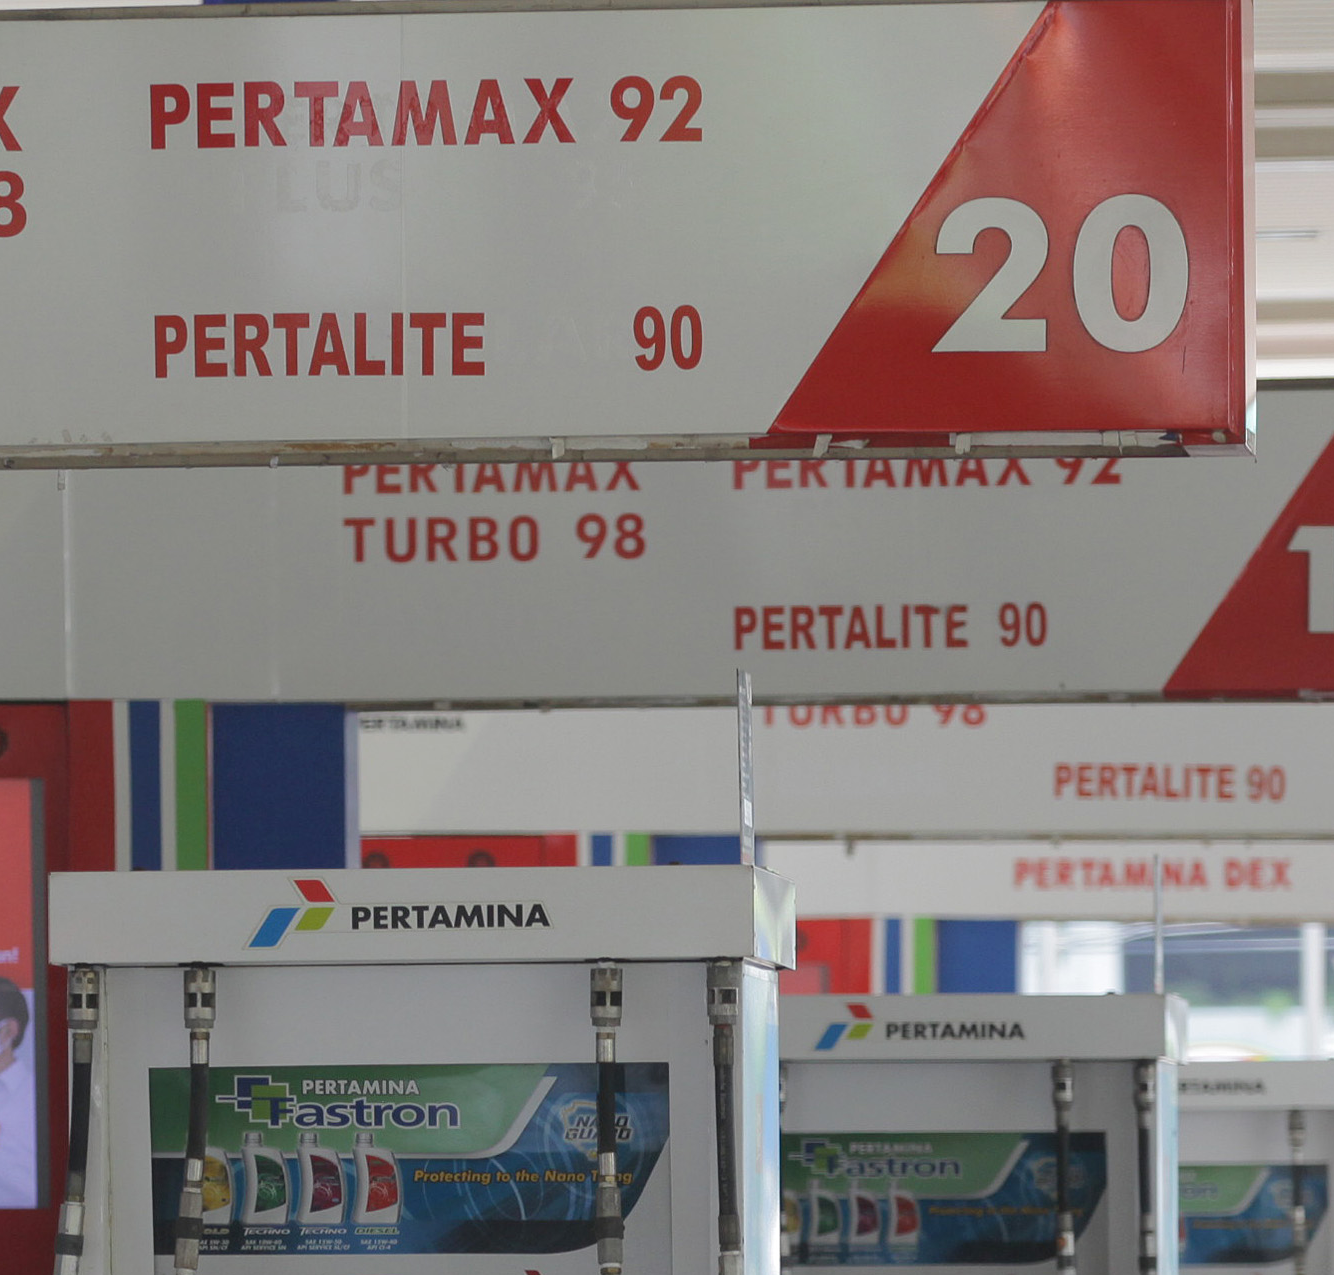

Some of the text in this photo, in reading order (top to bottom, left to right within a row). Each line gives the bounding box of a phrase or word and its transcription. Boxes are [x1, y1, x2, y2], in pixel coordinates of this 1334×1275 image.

[150, 74, 703, 150] PERTAMAX 92
[930, 193, 1190, 354] 20
[155, 305, 703, 379] PERTALITE 90
[343, 462, 639, 494] PERTAMAX
[733, 458, 1031, 490] PERTAMAX
[343, 512, 647, 563] TURBO 98
[734, 602, 1049, 651] PERTALITE 90
[1054, 763, 1286, 802] PERTALITE 90
[1013, 857, 1291, 892] PERTAMNA DEX
[350, 903, 550, 930] PERTAMINA
[885, 1022, 1025, 1040] PERTAMINA
[302, 1080, 420, 1095] PERTAMINA
[267, 1097, 461, 1128] Fastron
[575, 1116, 630, 1128] NO
[565, 1128, 633, 1140] GUD
[414, 1170, 634, 1185] Protecting to the Nano Tng
[243, 1227, 291, 1235] TECHNO
[300, 1227, 347, 1235] TECHNO
[354, 1227, 400, 1235] DIESEL
